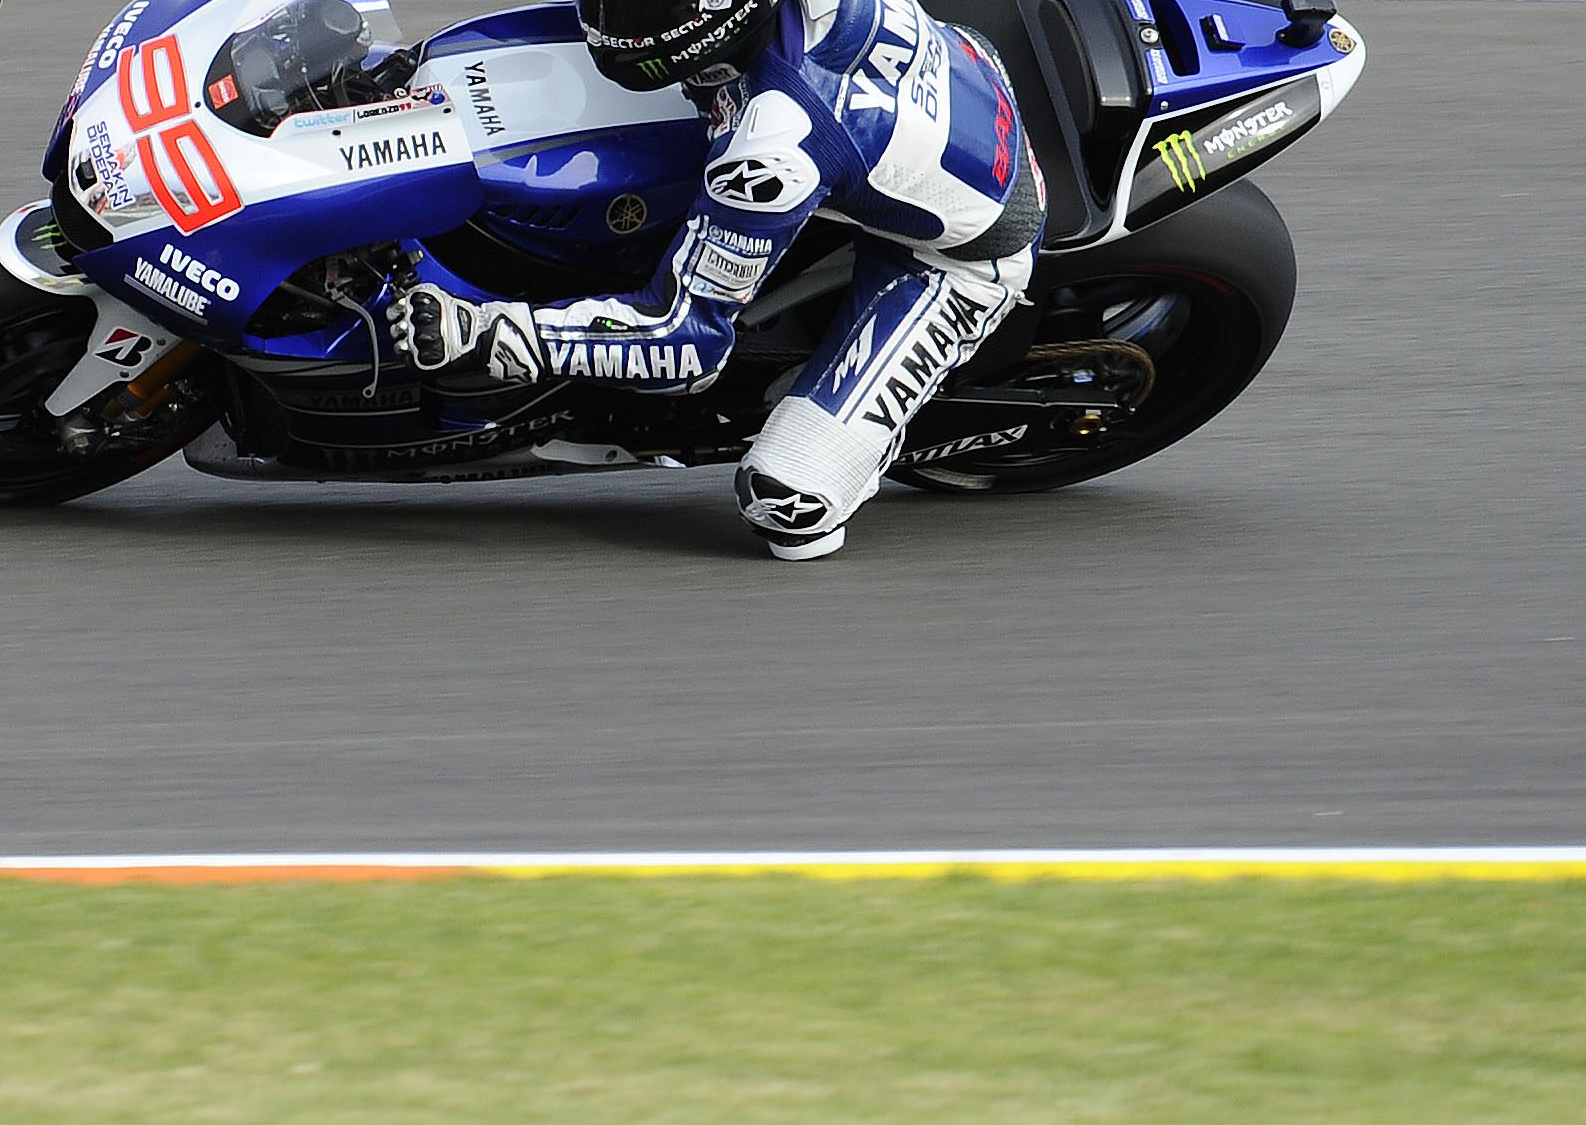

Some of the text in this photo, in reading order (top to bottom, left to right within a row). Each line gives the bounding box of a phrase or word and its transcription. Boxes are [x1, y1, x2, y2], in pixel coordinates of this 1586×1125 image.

[98, 0, 150, 69] IVECO
[602, 34, 655, 49] SECTOR
[661, 13, 712, 42] SECTOR
[671, 0, 758, 63] MONSTER
[294, 112, 351, 128] twitter
[464, 60, 506, 138] YAMAHA
[1203, 101, 1293, 155] MONSTER
[97, 120, 135, 207] SEMAKIN
[117, 33, 245, 236] 99
[339, 131, 447, 171] YAMAHA
[86, 124, 123, 211] DI DEPAN
[723, 229, 773, 253] YAMAHA
[134, 256, 210, 318] YAMALUBE
[159, 243, 241, 302] IVECO
[546, 342, 704, 380] YAMAHA
[861, 289, 990, 433] YAMAHA
[386, 408, 575, 458] MONSTER
